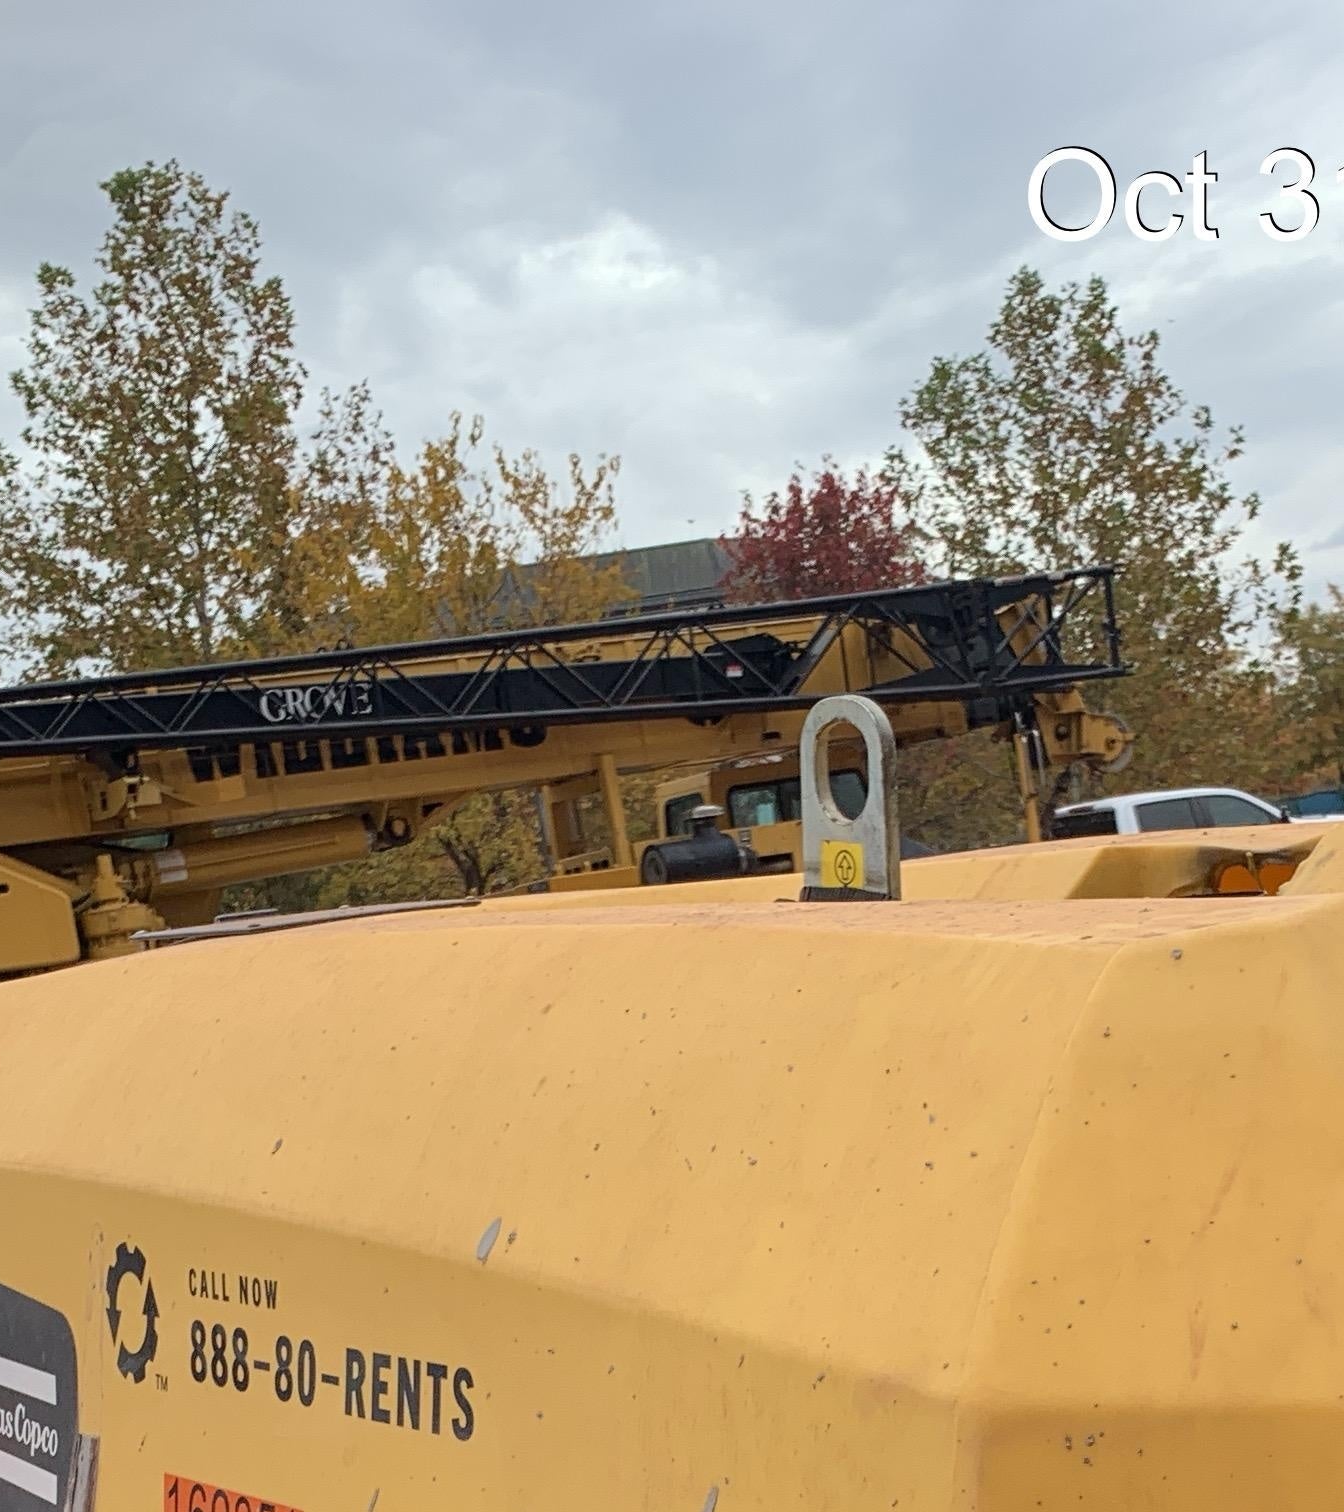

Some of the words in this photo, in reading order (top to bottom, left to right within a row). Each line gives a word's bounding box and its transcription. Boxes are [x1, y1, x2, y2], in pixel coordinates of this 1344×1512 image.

[259, 682, 374, 724] GROVE
[189, 1269, 231, 1303] CALL
[238, 1274, 279, 1310] NOW
[189, 1320, 476, 1442] 888-80-RENTS
